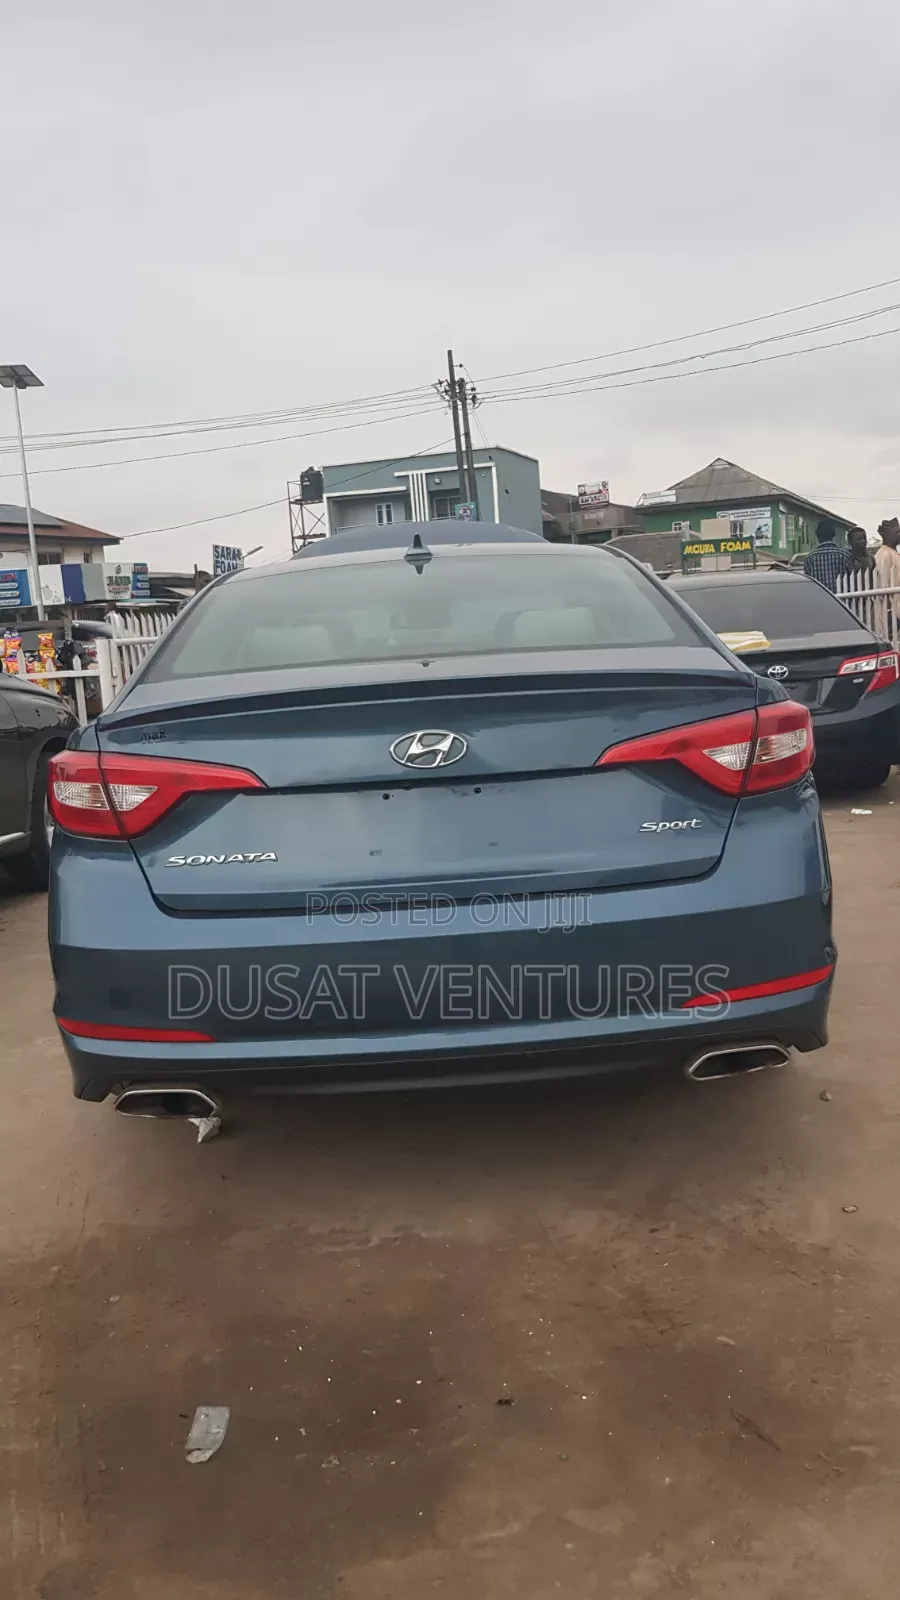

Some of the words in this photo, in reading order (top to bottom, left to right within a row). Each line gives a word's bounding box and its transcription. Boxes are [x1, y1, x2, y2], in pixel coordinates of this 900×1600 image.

[720, 540, 751, 552] FOAM
[639, 818, 702, 833] Sport
[164, 852, 279, 868] SONATA
